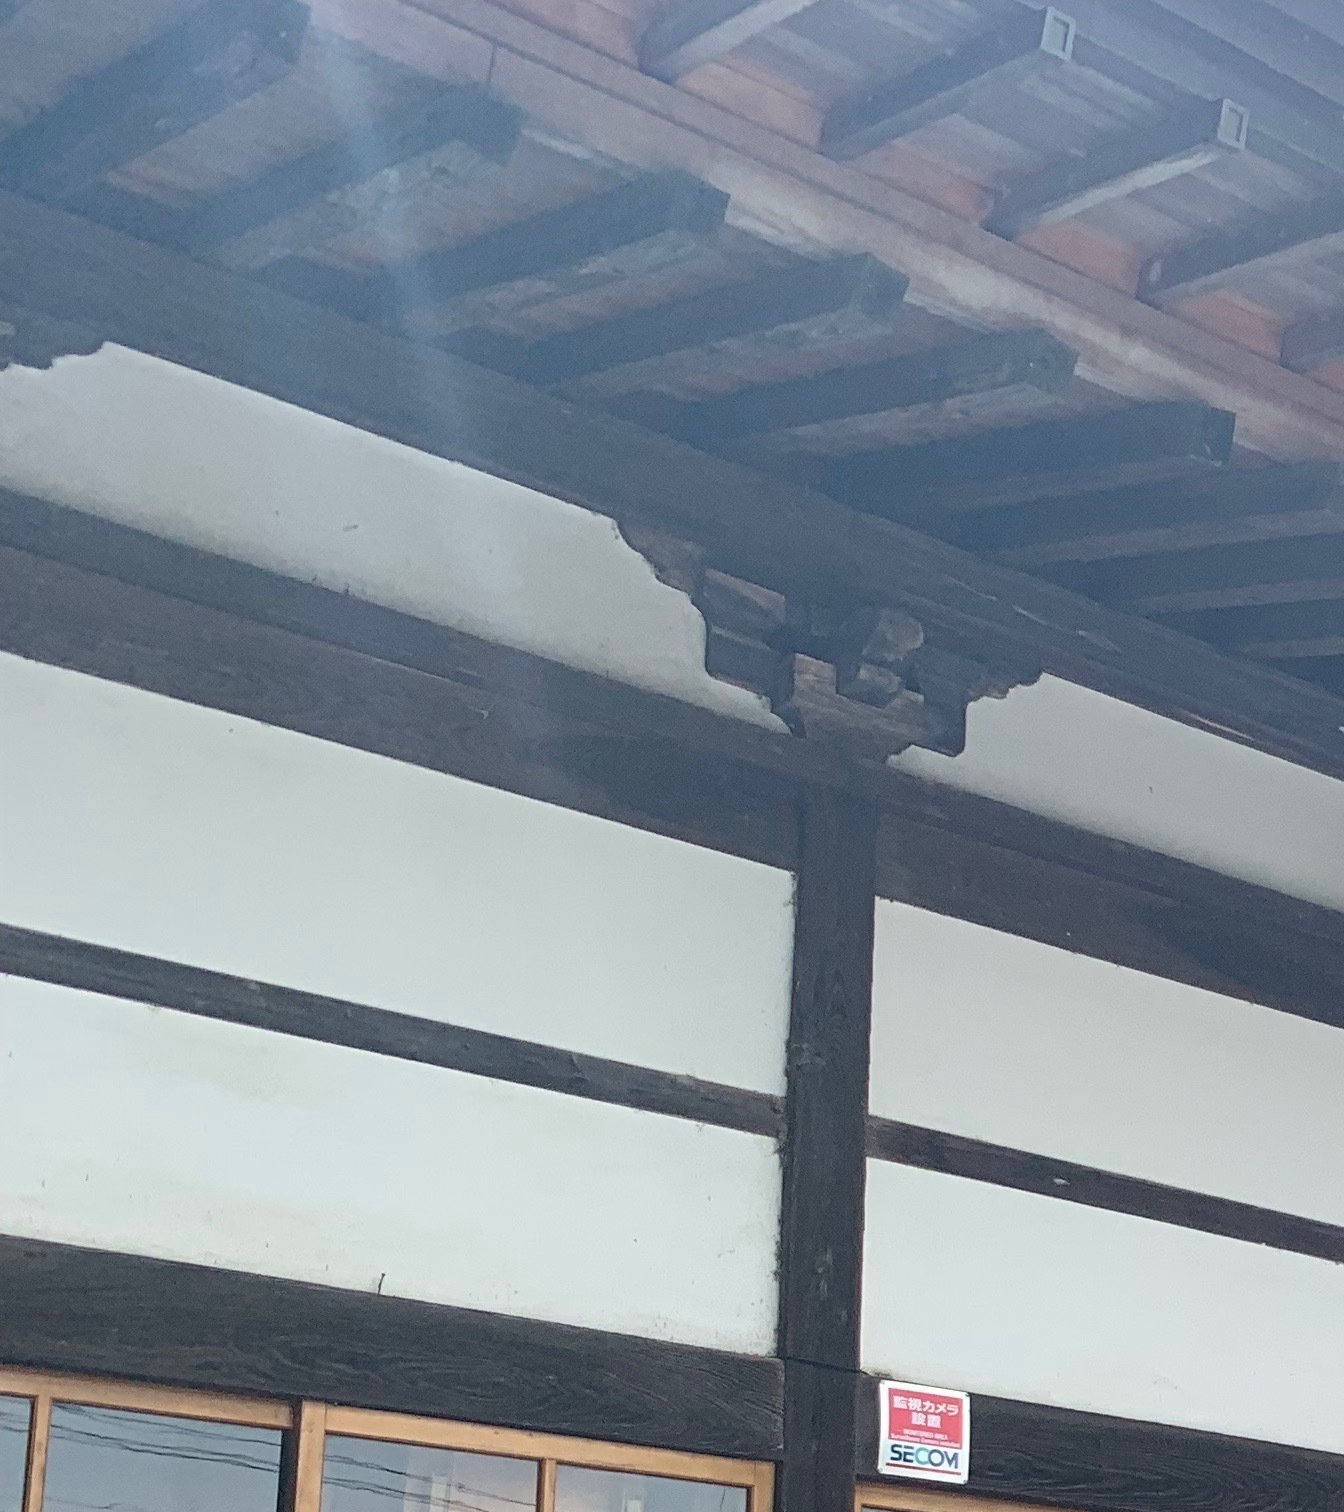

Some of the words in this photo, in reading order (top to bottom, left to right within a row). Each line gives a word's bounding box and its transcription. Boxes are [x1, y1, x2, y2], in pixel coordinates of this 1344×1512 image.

[893, 1395, 959, 1416] 監視カメラ
[911, 1411, 941, 1429] 設置
[890, 1444, 959, 1469] SECOM
